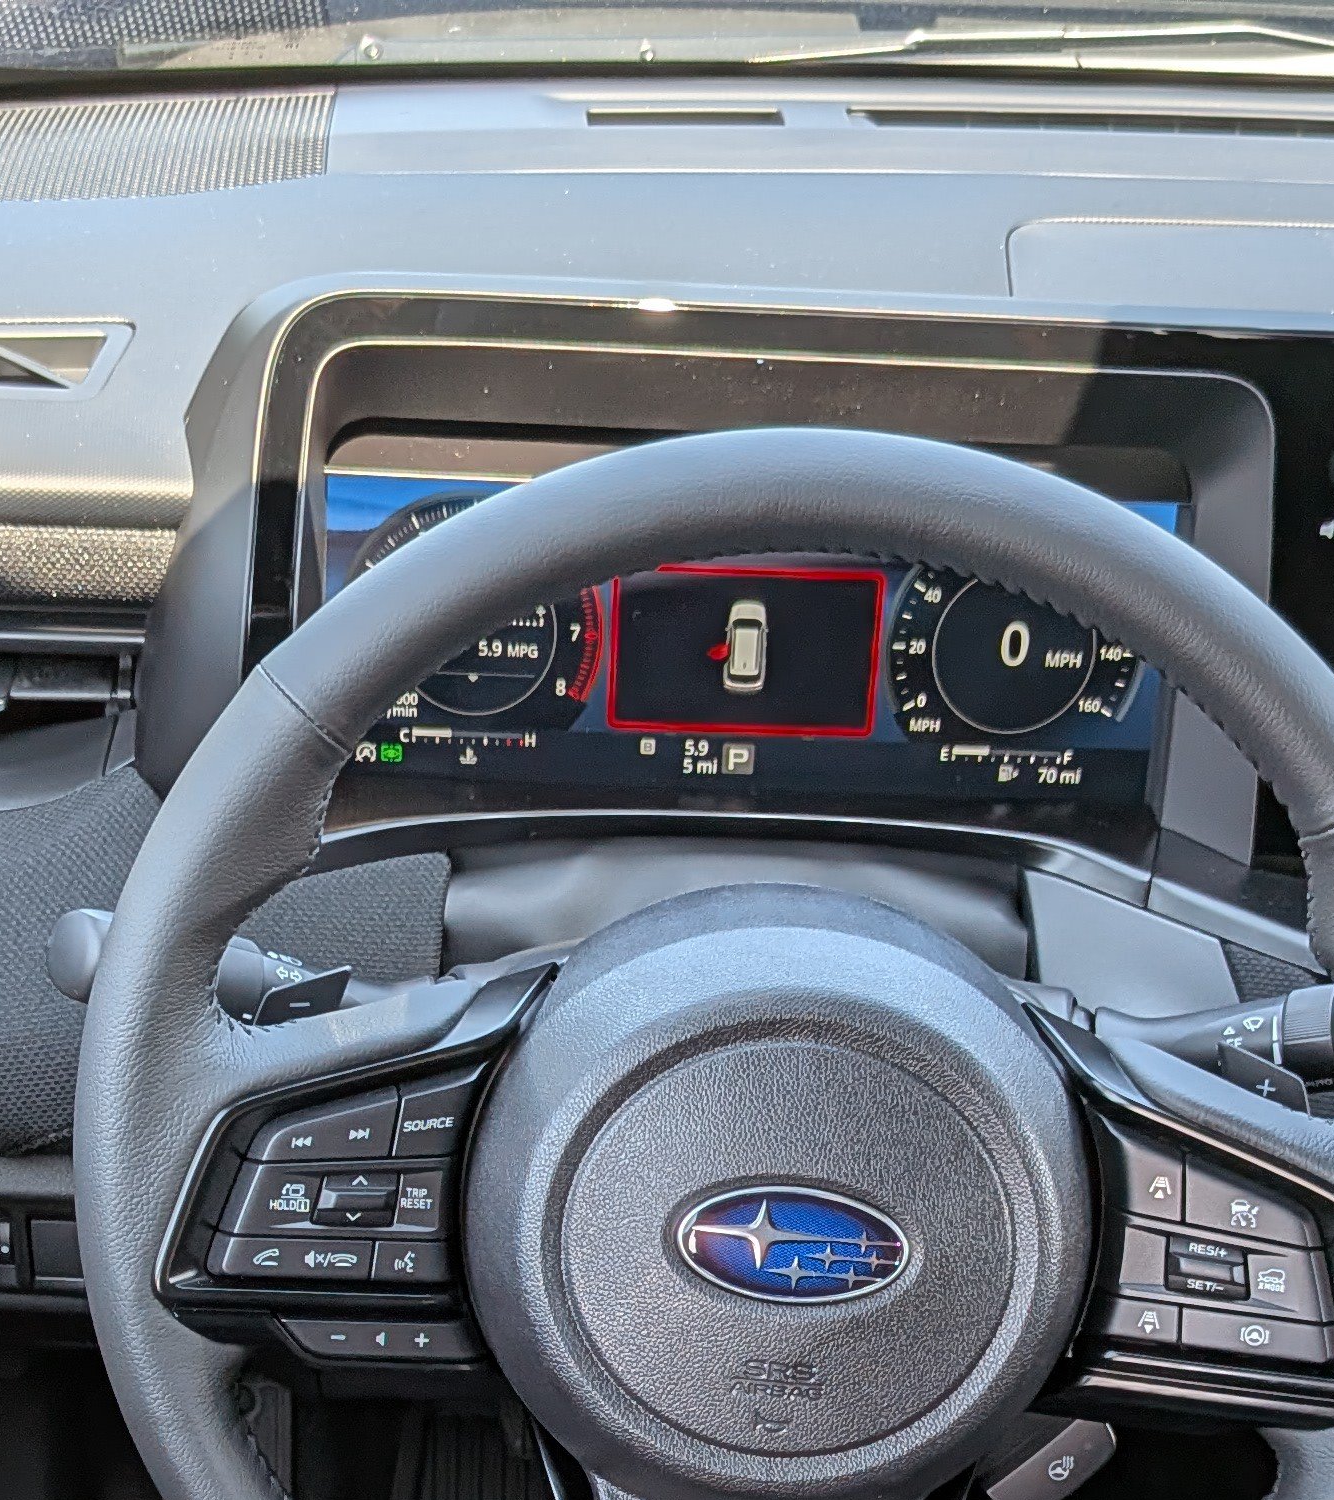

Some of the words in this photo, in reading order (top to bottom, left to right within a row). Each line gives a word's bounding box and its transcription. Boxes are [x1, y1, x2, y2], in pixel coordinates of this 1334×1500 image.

[924, 587, 942, 603] 40
[569, 622, 581, 642] 7
[478, 639, 503, 657] 5.9
[507, 643, 539, 659] MPG
[909, 640, 926, 655] 20
[1000, 620, 1030, 667] 0
[1045, 651, 1082, 669] MPH
[1099, 645, 1122, 661] 140
[555, 677, 566, 697] 8
[917, 693, 927, 708] 0
[1078, 698, 1102, 714] 160
[909, 718, 941, 733] MPH
[400, 727, 410, 743] C
[524, 732, 536, 748] H
[684, 738, 709, 756] 5.9
[940, 747, 950, 762] E
[1063, 749, 1073, 764] F
[682, 758, 693, 774] 5
[696, 757, 717, 775] mi
[728, 749, 749, 771] P
[1038, 768, 1057, 784] 70
[1059, 768, 1082, 784] mi
[403, 1116, 454, 1133] SOURCE
[406, 1187, 427, 1197] TRIP
[269, 1199, 296, 1211] HOLD
[400, 1198, 433, 1209] RESET
